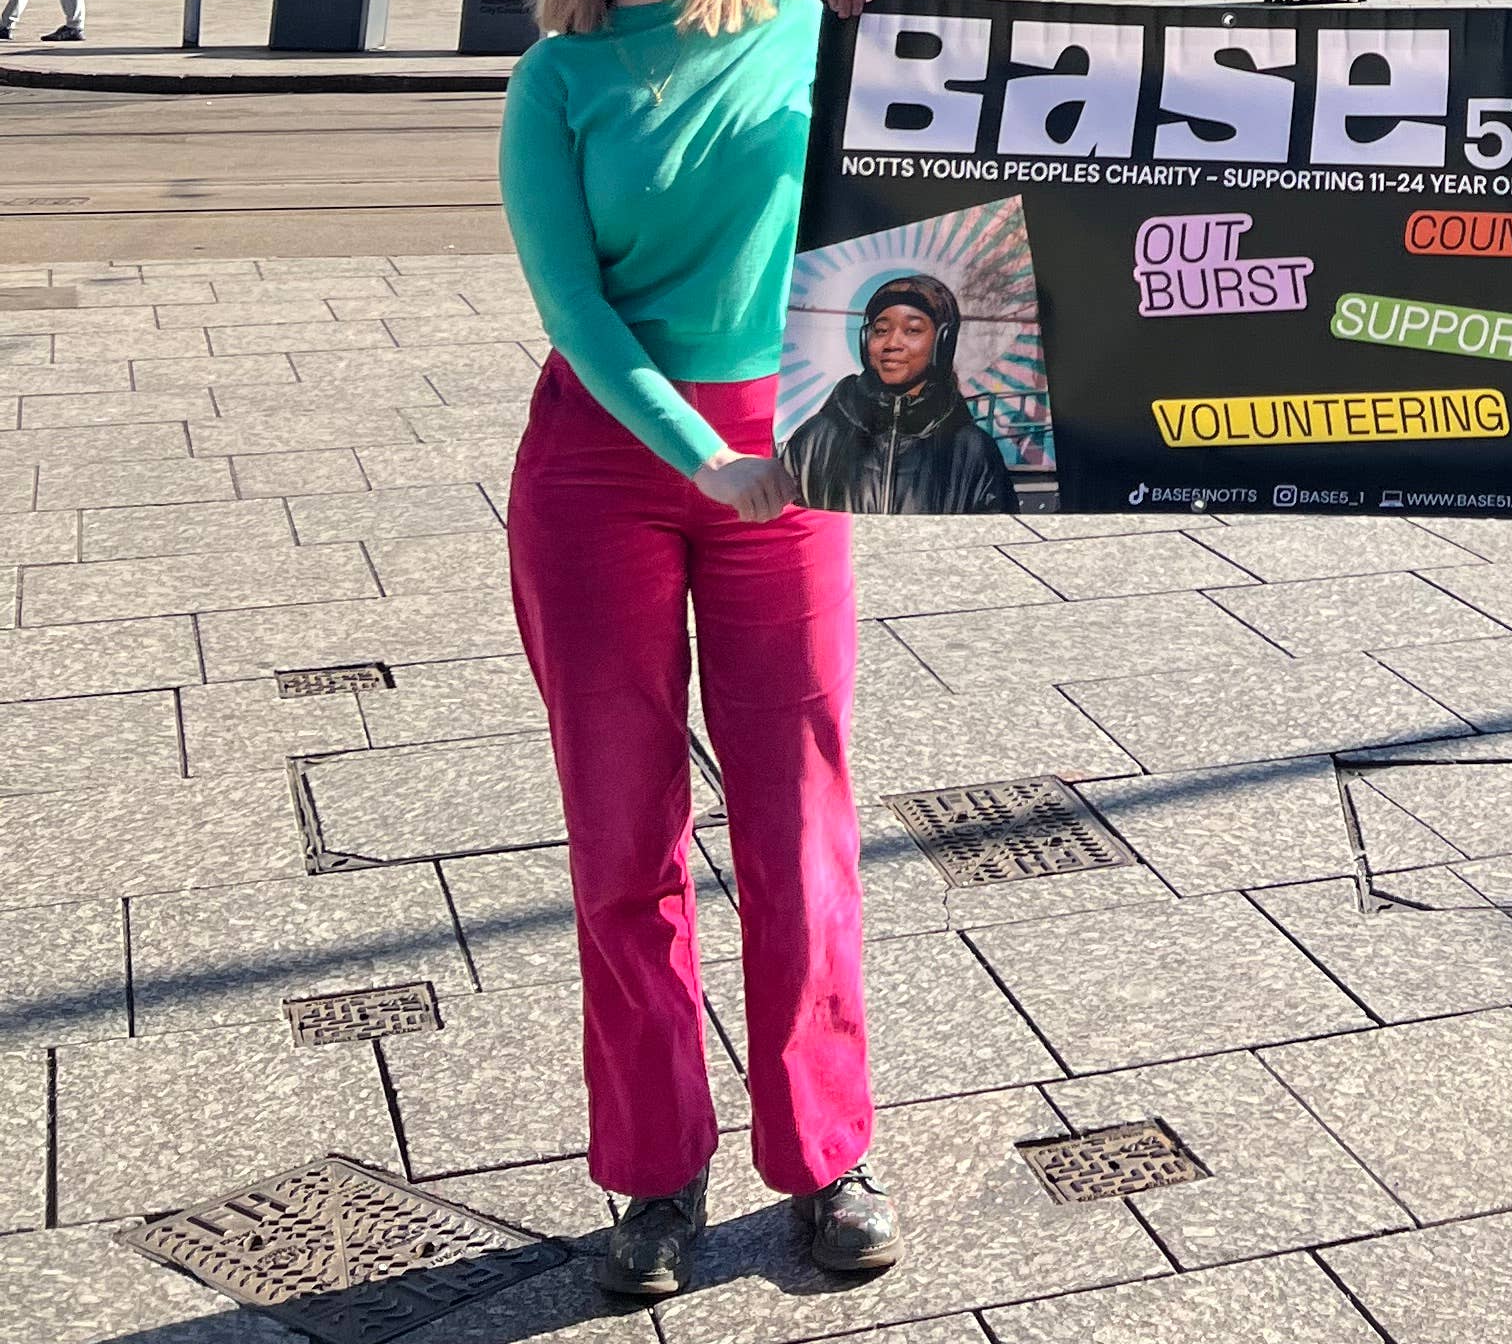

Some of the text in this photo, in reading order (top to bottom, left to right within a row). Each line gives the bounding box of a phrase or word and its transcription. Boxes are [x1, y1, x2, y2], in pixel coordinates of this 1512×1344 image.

[842, 13, 1450, 168] Base
[842, 156, 913, 179] NOTTS
[920, 159, 999, 181] YOUNG
[1004, 161, 1100, 184] PEOPLES
[1106, 164, 1201, 187] CHARITY
[1223, 168, 1364, 192] SUPPORTING
[1370, 172, 1425, 194] 11-24
[1431, 173, 1487, 195] YEAR
[1143, 219, 1244, 267] OUT
[1141, 263, 1308, 312] BURST
[1159, 394, 1505, 442] VOLUNTEERING
